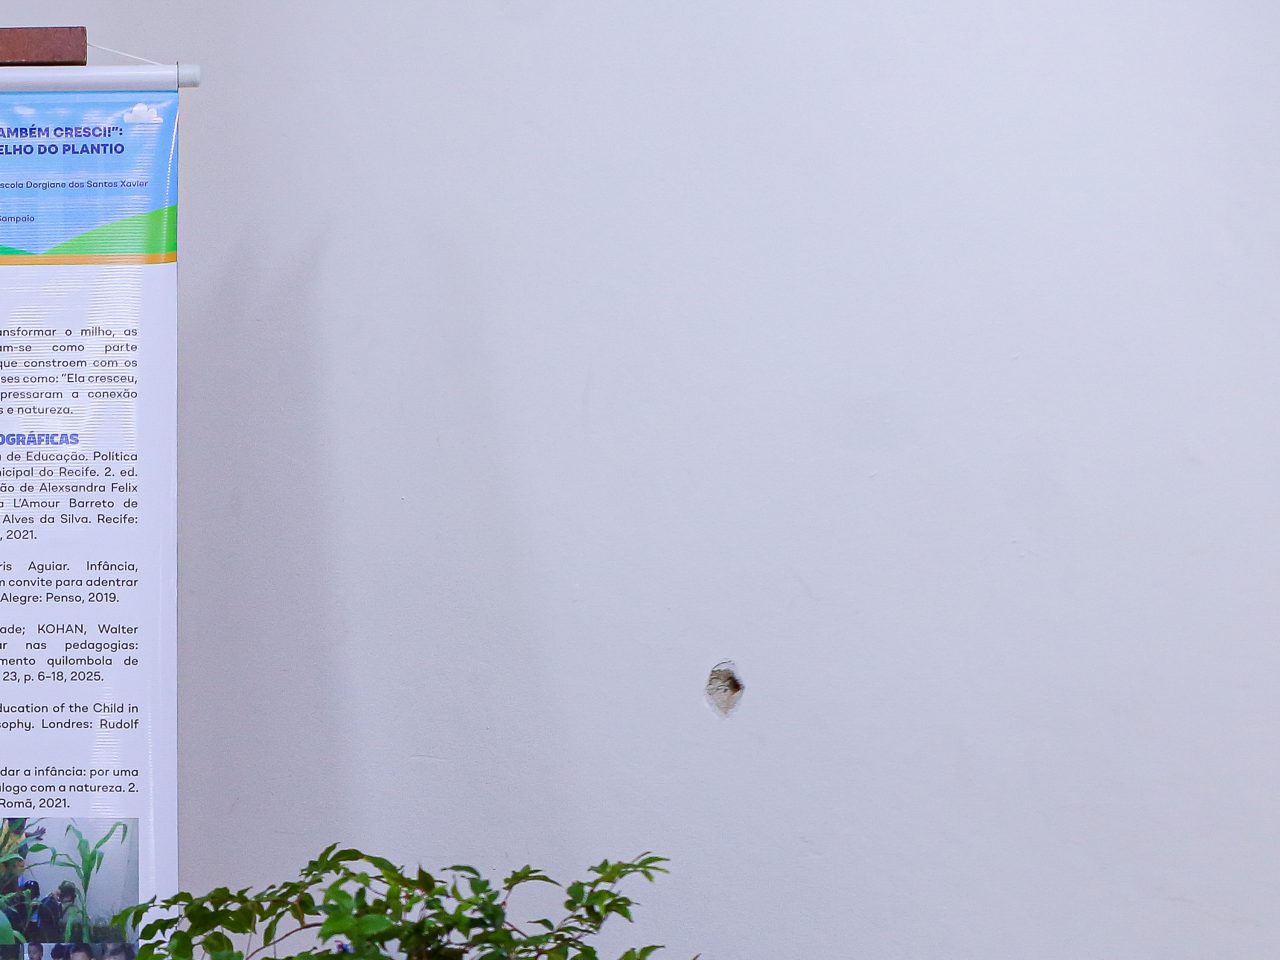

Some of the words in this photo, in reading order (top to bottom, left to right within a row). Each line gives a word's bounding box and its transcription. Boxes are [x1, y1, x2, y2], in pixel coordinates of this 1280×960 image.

[37, 143, 59, 156] DO
[62, 142, 125, 156] PLANTIO
[25, 180, 67, 191] Dorgiane
[68, 180, 85, 189] dos
[86, 179, 119, 189] Santos
[119, 179, 149, 188] Xavier
[51, 344, 85, 352] como
[104, 342, 138, 355] parte
[6, 450, 22, 462] de
[26, 450, 89, 464] Educação.
[92, 450, 138, 462] Política
[27, 560, 70, 574] Aguiar.
[86, 560, 139, 573] Infância,
[37, 623, 87, 636] KOHAN,
[97, 623, 139, 635] Walter
[41, 718, 93, 729] Londres:
[99, 718, 140, 730] Rudolf
[38, 797, 71, 809] 2021.
